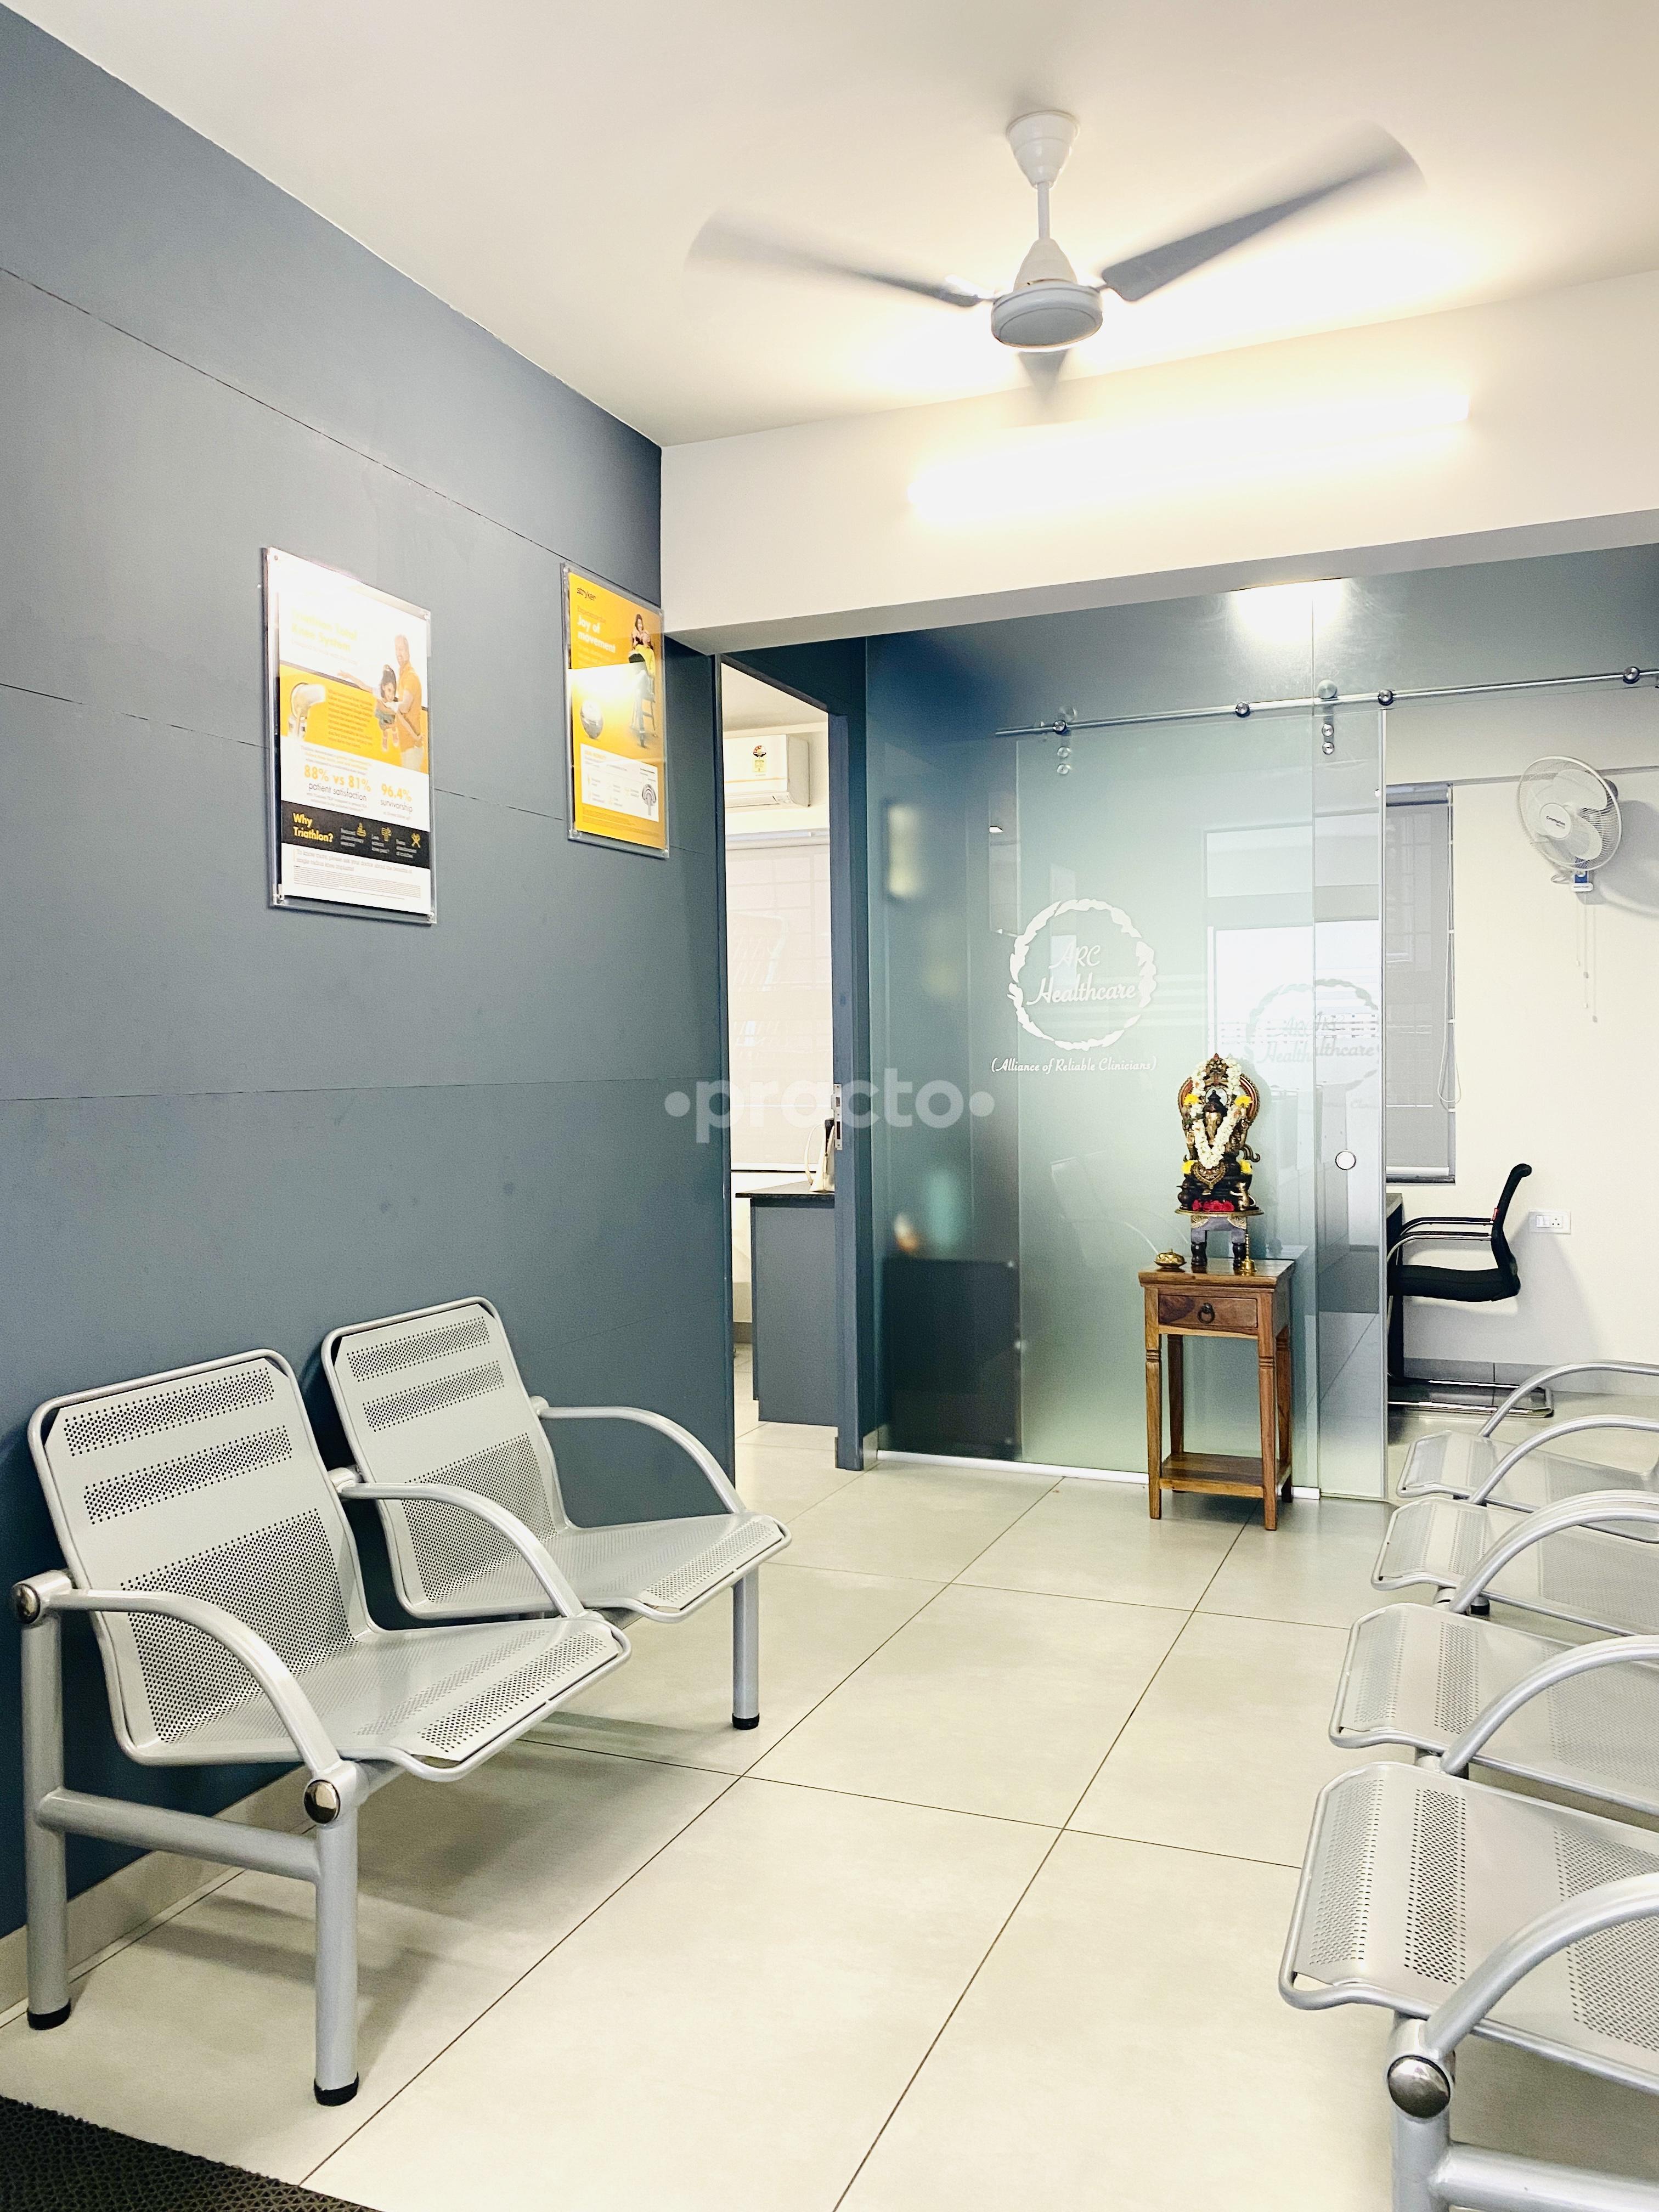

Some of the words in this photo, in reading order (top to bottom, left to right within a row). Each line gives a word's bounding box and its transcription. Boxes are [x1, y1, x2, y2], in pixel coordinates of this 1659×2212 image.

[577, 614, 591, 632] Joy
[592, 622, 601, 634] of
[578, 631, 616, 653] movement
[304, 764, 329, 782] 88%
[334, 775, 345, 786] vs
[348, 775, 371, 792] 81%
[308, 783, 331, 793] patient
[333, 788, 367, 802] satisfaction
[381, 783, 412, 802] 96.4%
[292, 812, 313, 828] Why
[292, 826, 334, 843] Triathlon?
[1048, 944, 1101, 969] ARC
[1026, 972, 1136, 1006] Healthcare
[991, 1057, 1040, 1073] (Alliance
[1042, 1058, 1056, 1074] of
[1056, 1056, 1095, 1071] Reliable
[1098, 1055, 1158, 1071] Clinicians)
